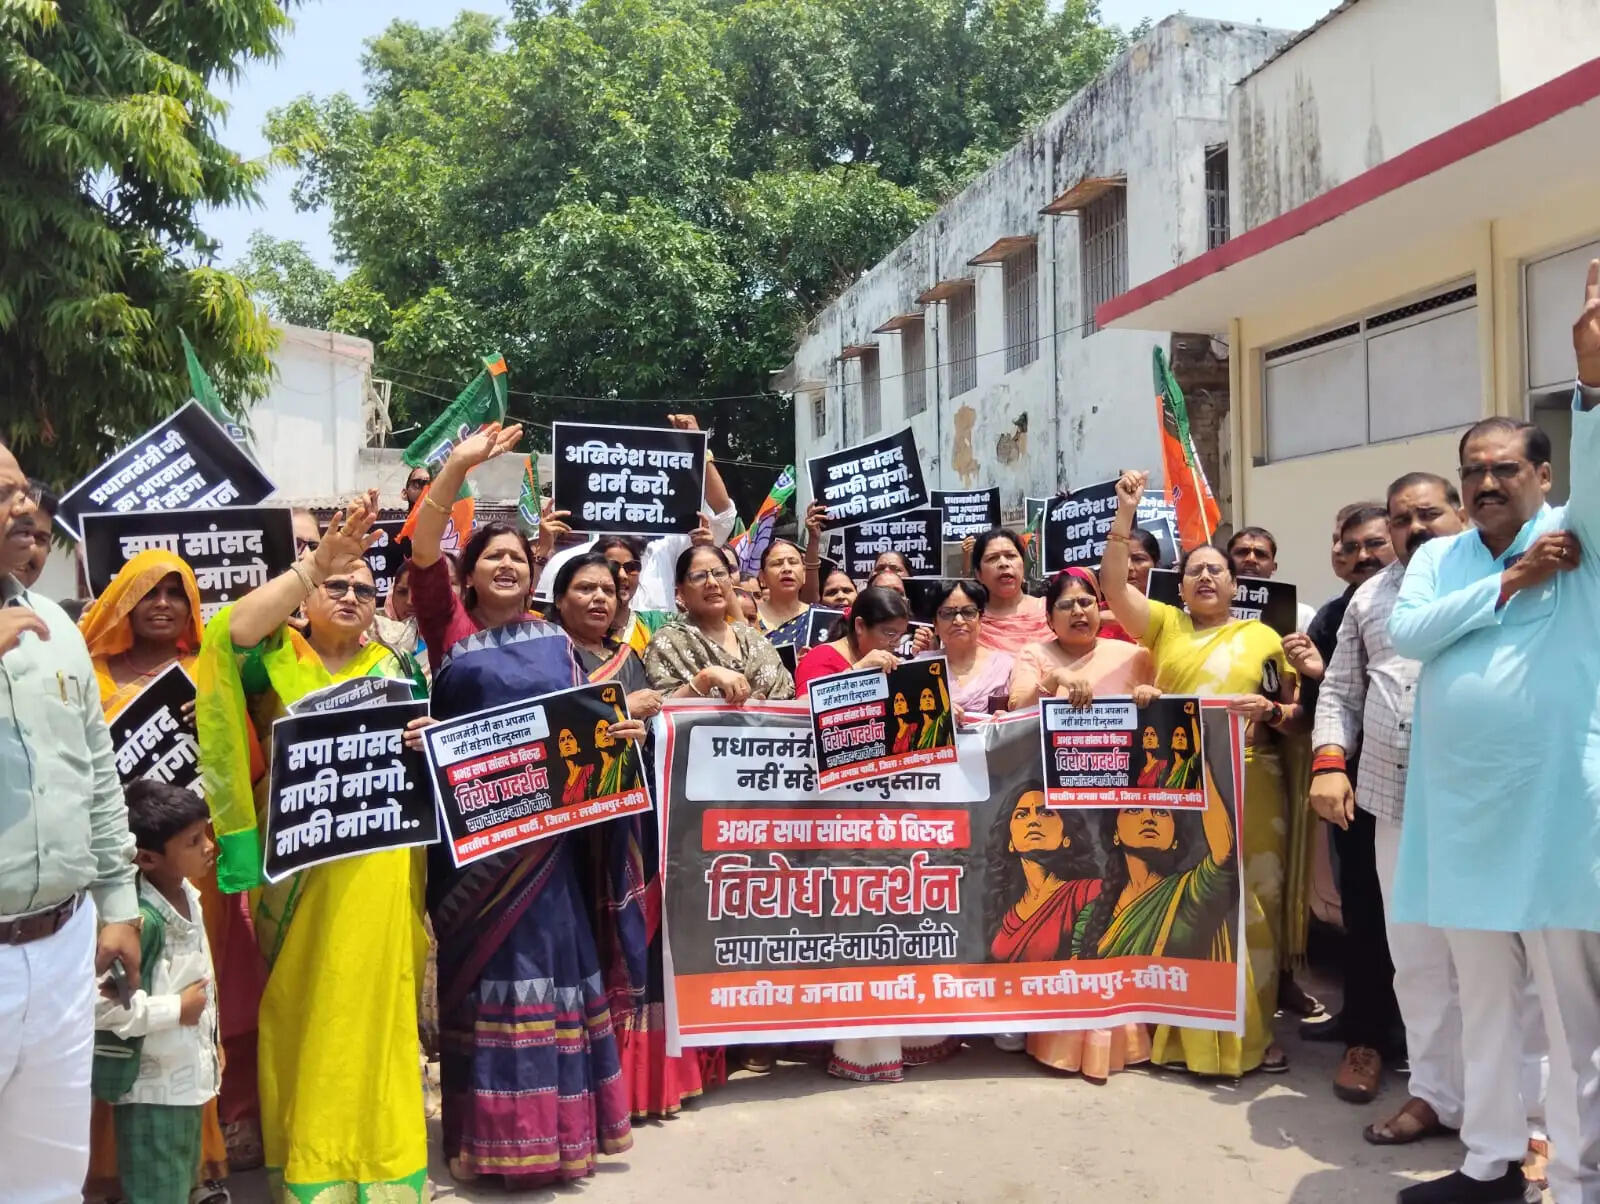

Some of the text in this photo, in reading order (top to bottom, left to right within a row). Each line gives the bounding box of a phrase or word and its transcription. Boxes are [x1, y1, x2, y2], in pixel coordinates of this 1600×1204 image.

[89, 444, 166, 505] प्रधानमंत्री
[159, 430, 186, 454] जी
[565, 440, 694, 469] अखिलेश यादव
[827, 446, 904, 480] सपा सांसद
[136, 452, 196, 498] अपमान
[160, 472, 207, 508] सहेगा
[588, 468, 675, 496] शर्म करो.
[824, 474, 867, 500] माफी
[868, 463, 913, 489] मांगो.
[583, 496, 676, 524] शर्म करो..
[825, 485, 920, 520] माफी मांगो..
[1051, 498, 1106, 523] अखिलेश
[1105, 497, 1121, 512] या
[182, 523, 264, 558] सांसद
[855, 536, 892, 554] माफी
[893, 535, 932, 553] मांगो.
[860, 518, 927, 536] सपा सांसद
[1066, 516, 1096, 540] शर्म
[1063, 539, 1093, 562] शर्म
[115, 705, 180, 775] सांसद
[480, 721, 491, 733] जी
[491, 720, 504, 731] का
[821, 718, 885, 753] विरोध प्रदर्शन
[288, 724, 404, 772] सपा सांसद
[712, 732, 815, 759] प्रधानमंत्री
[1055, 747, 1130, 771] विरोध प्रदर्शन
[280, 759, 414, 814] माफी मांगो.
[454, 764, 549, 814] विरोध प्रदर्शन
[737, 761, 785, 792] नहीं
[784, 763, 818, 792] सहे
[276, 798, 420, 857] माफी मांगो..
[717, 813, 955, 845] अभद्र सपा सांसद के विरुद्ध
[705, 850, 963, 921] विरोध प्रदर्शन
[716, 935, 766, 965] सपा
[902, 918, 958, 960] माँगो
[711, 979, 796, 1009] भारतीय
[801, 979, 864, 1004] जनता
[869, 973, 926, 1004] पार्टी,
[933, 973, 996, 999] जिला
[1020, 965, 1188, 1000] लखीमपुर-खीरी
